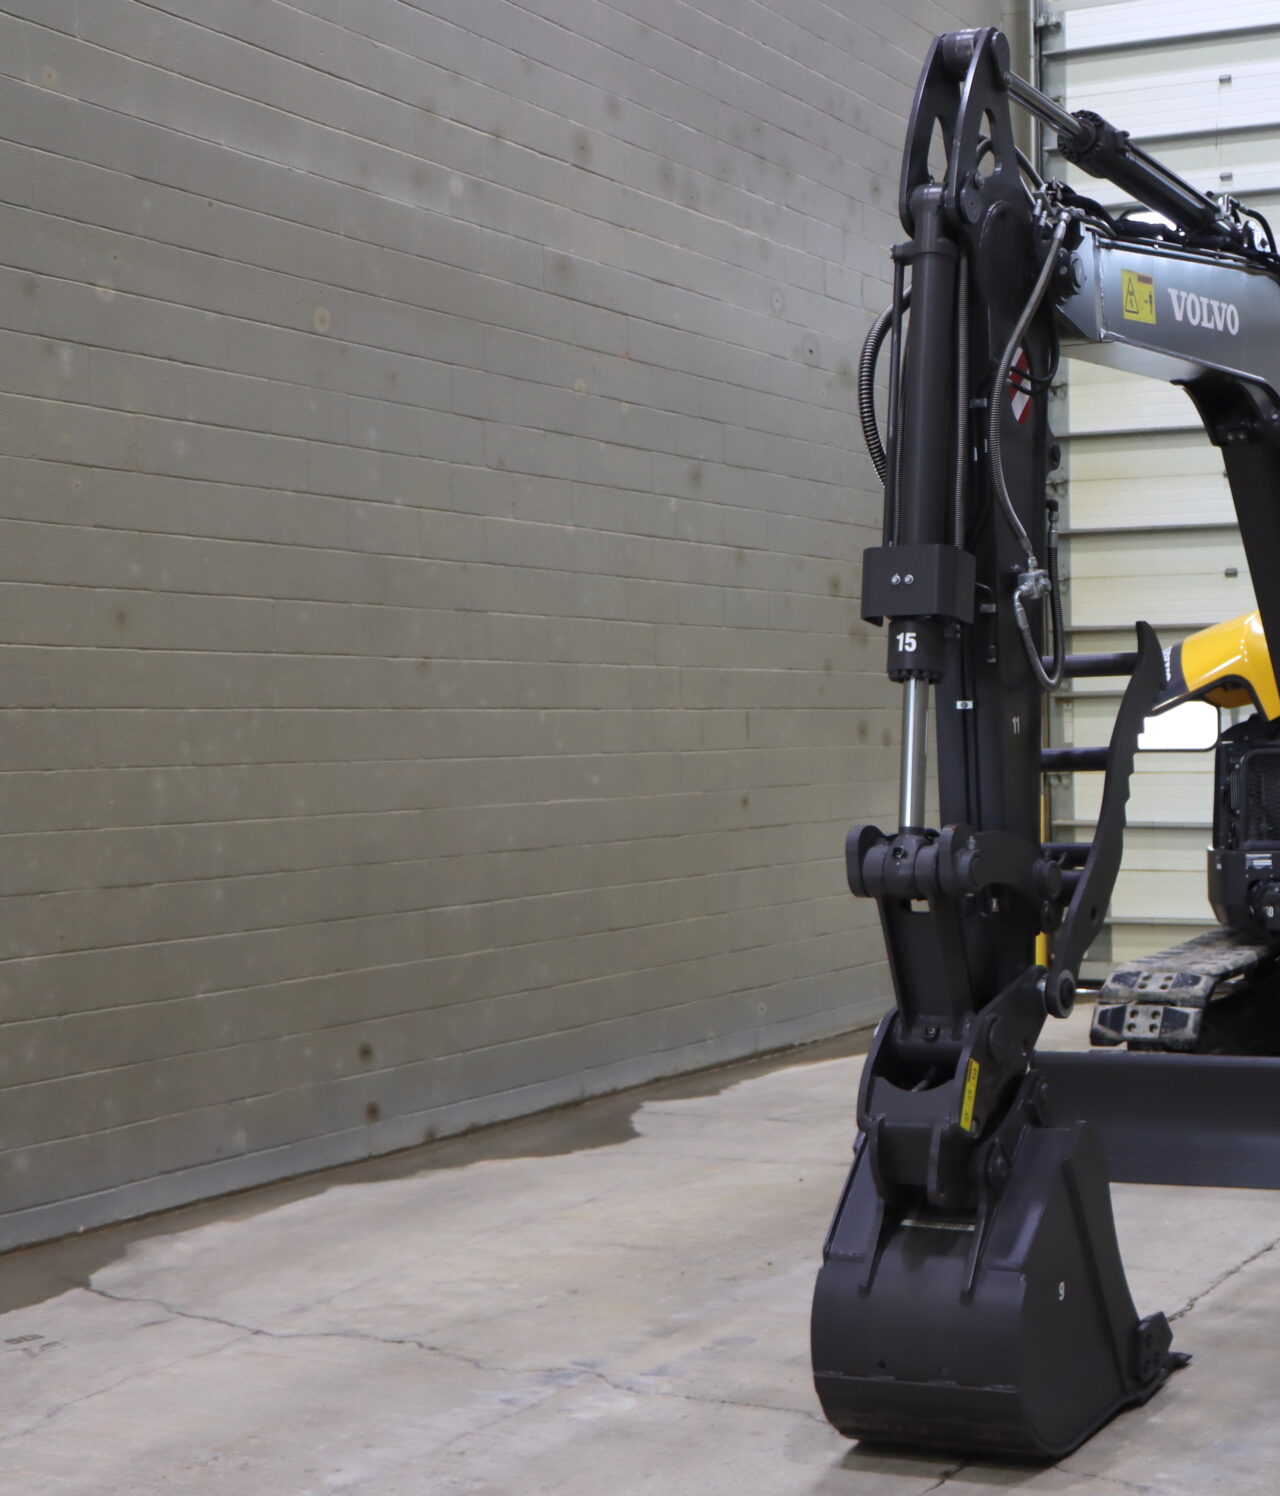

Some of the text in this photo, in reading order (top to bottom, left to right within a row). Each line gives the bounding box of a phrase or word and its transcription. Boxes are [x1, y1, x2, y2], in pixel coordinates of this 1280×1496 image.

[1167, 288, 1240, 336] VOLVO
[896, 632, 917, 652] 15
[1012, 716, 1020, 734] 11
